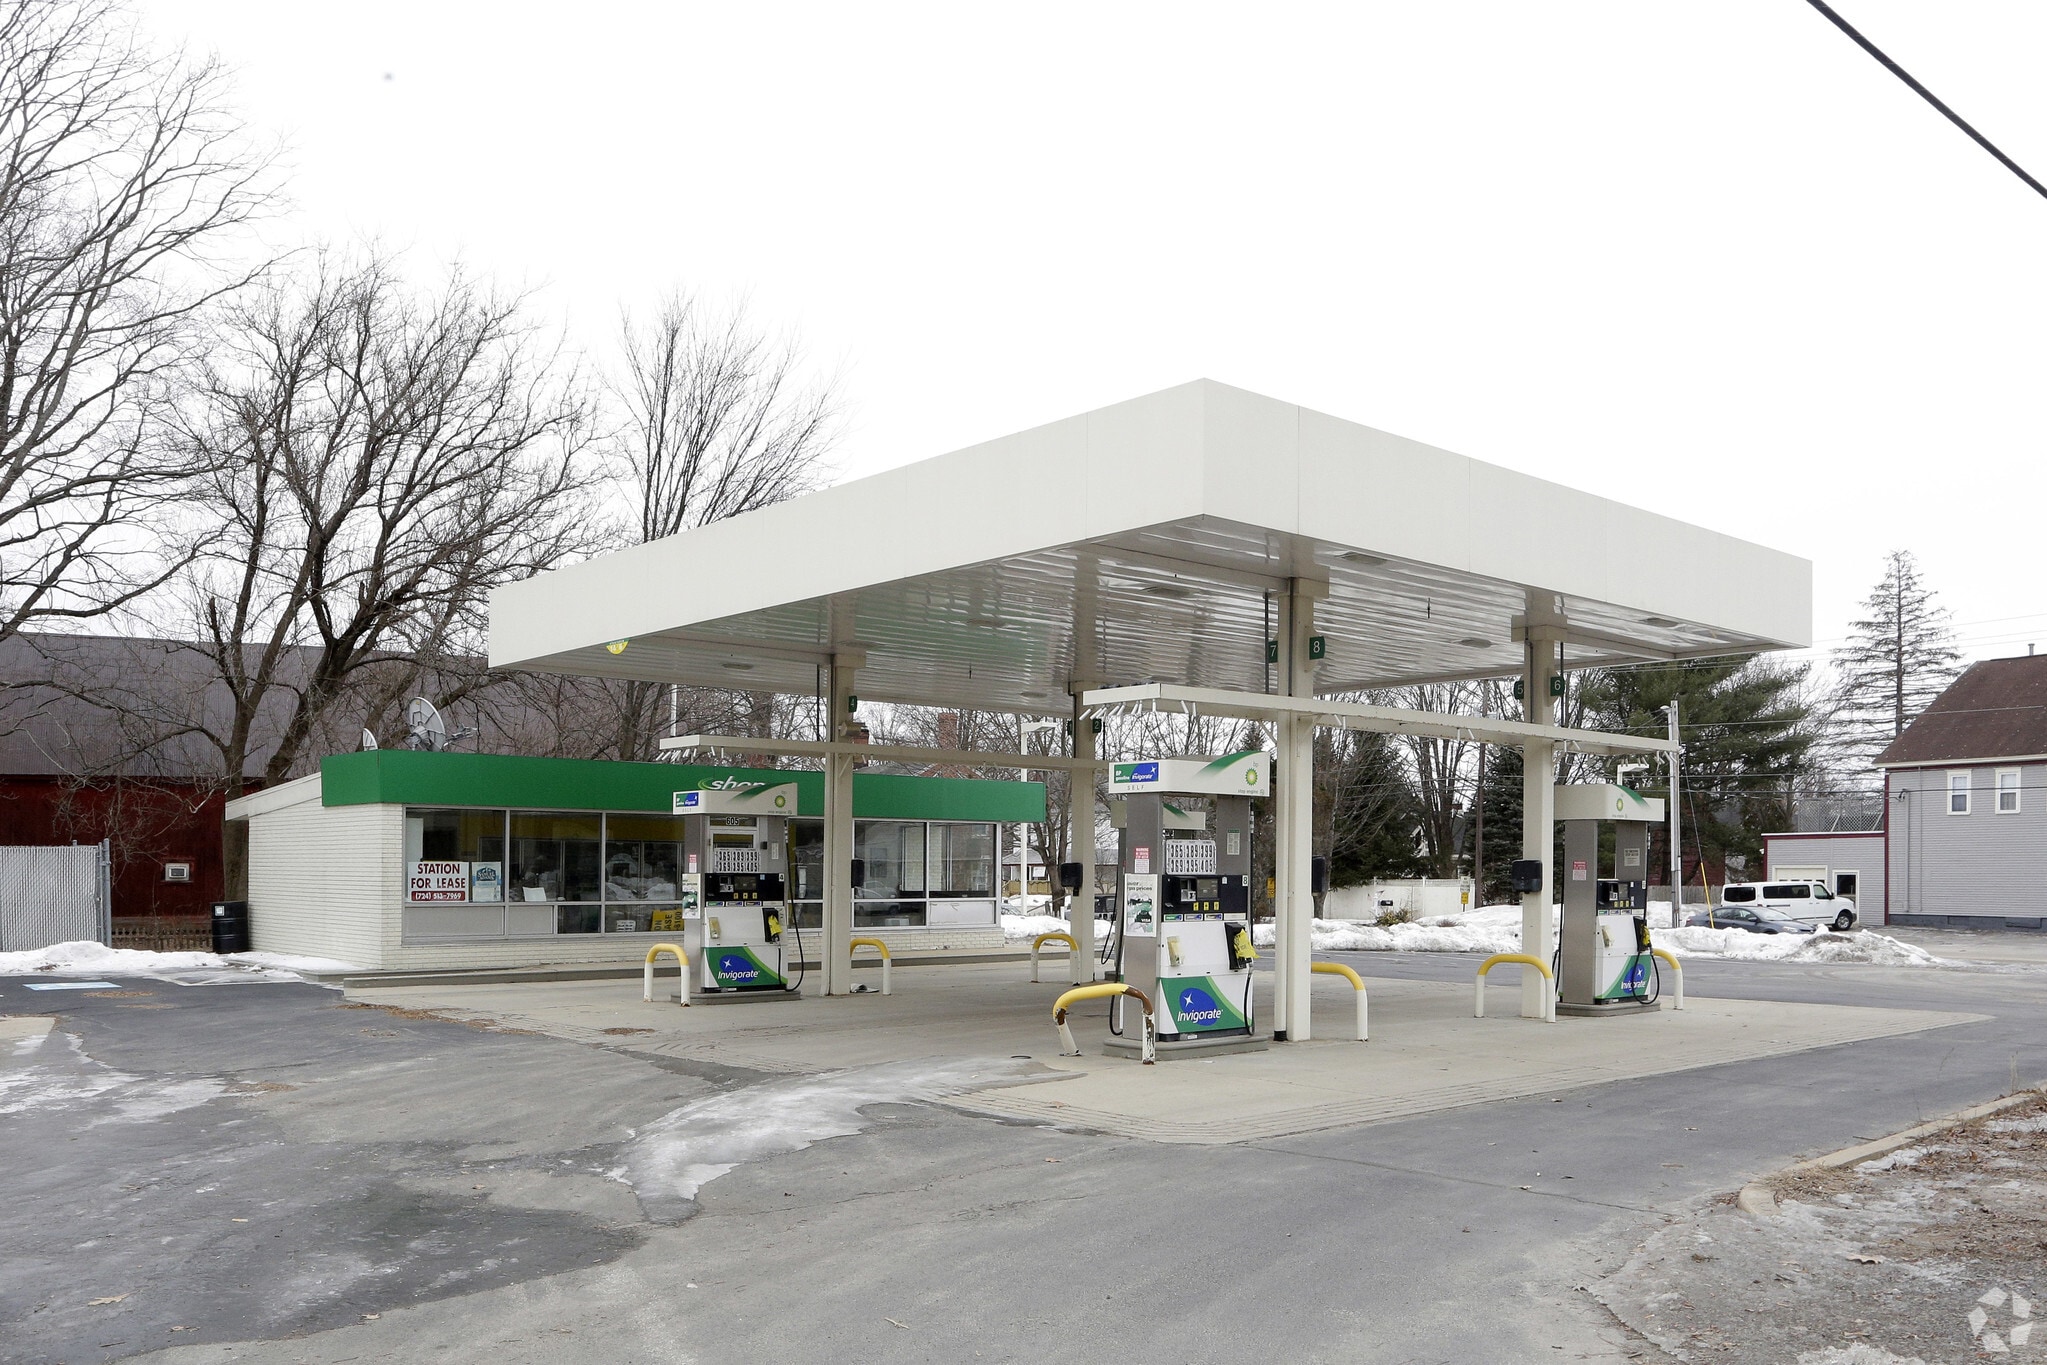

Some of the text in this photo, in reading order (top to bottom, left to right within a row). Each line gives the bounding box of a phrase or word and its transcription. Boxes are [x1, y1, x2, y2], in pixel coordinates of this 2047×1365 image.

[1270, 645, 1277, 657] 7
[1313, 641, 1320, 653] 8
[1517, 684, 1523, 694] 5
[1555, 680, 1561, 690] 6
[1094, 721, 1100, 730] 2
[711, 775, 765, 790] sh
[726, 817, 739, 825] 605
[1171, 844, 1183, 858] 365
[1186, 844, 1198, 858] 389
[417, 863, 460, 874] STATION
[1186, 859, 1198, 873] 395
[411, 878, 466, 889] FOR LEASE
[415, 892, 431, 900] (724)
[717, 970, 758, 981] Invigorate
[1621, 980, 1646, 991] Invigrate
[1177, 1009, 1222, 1024] Invigorate
